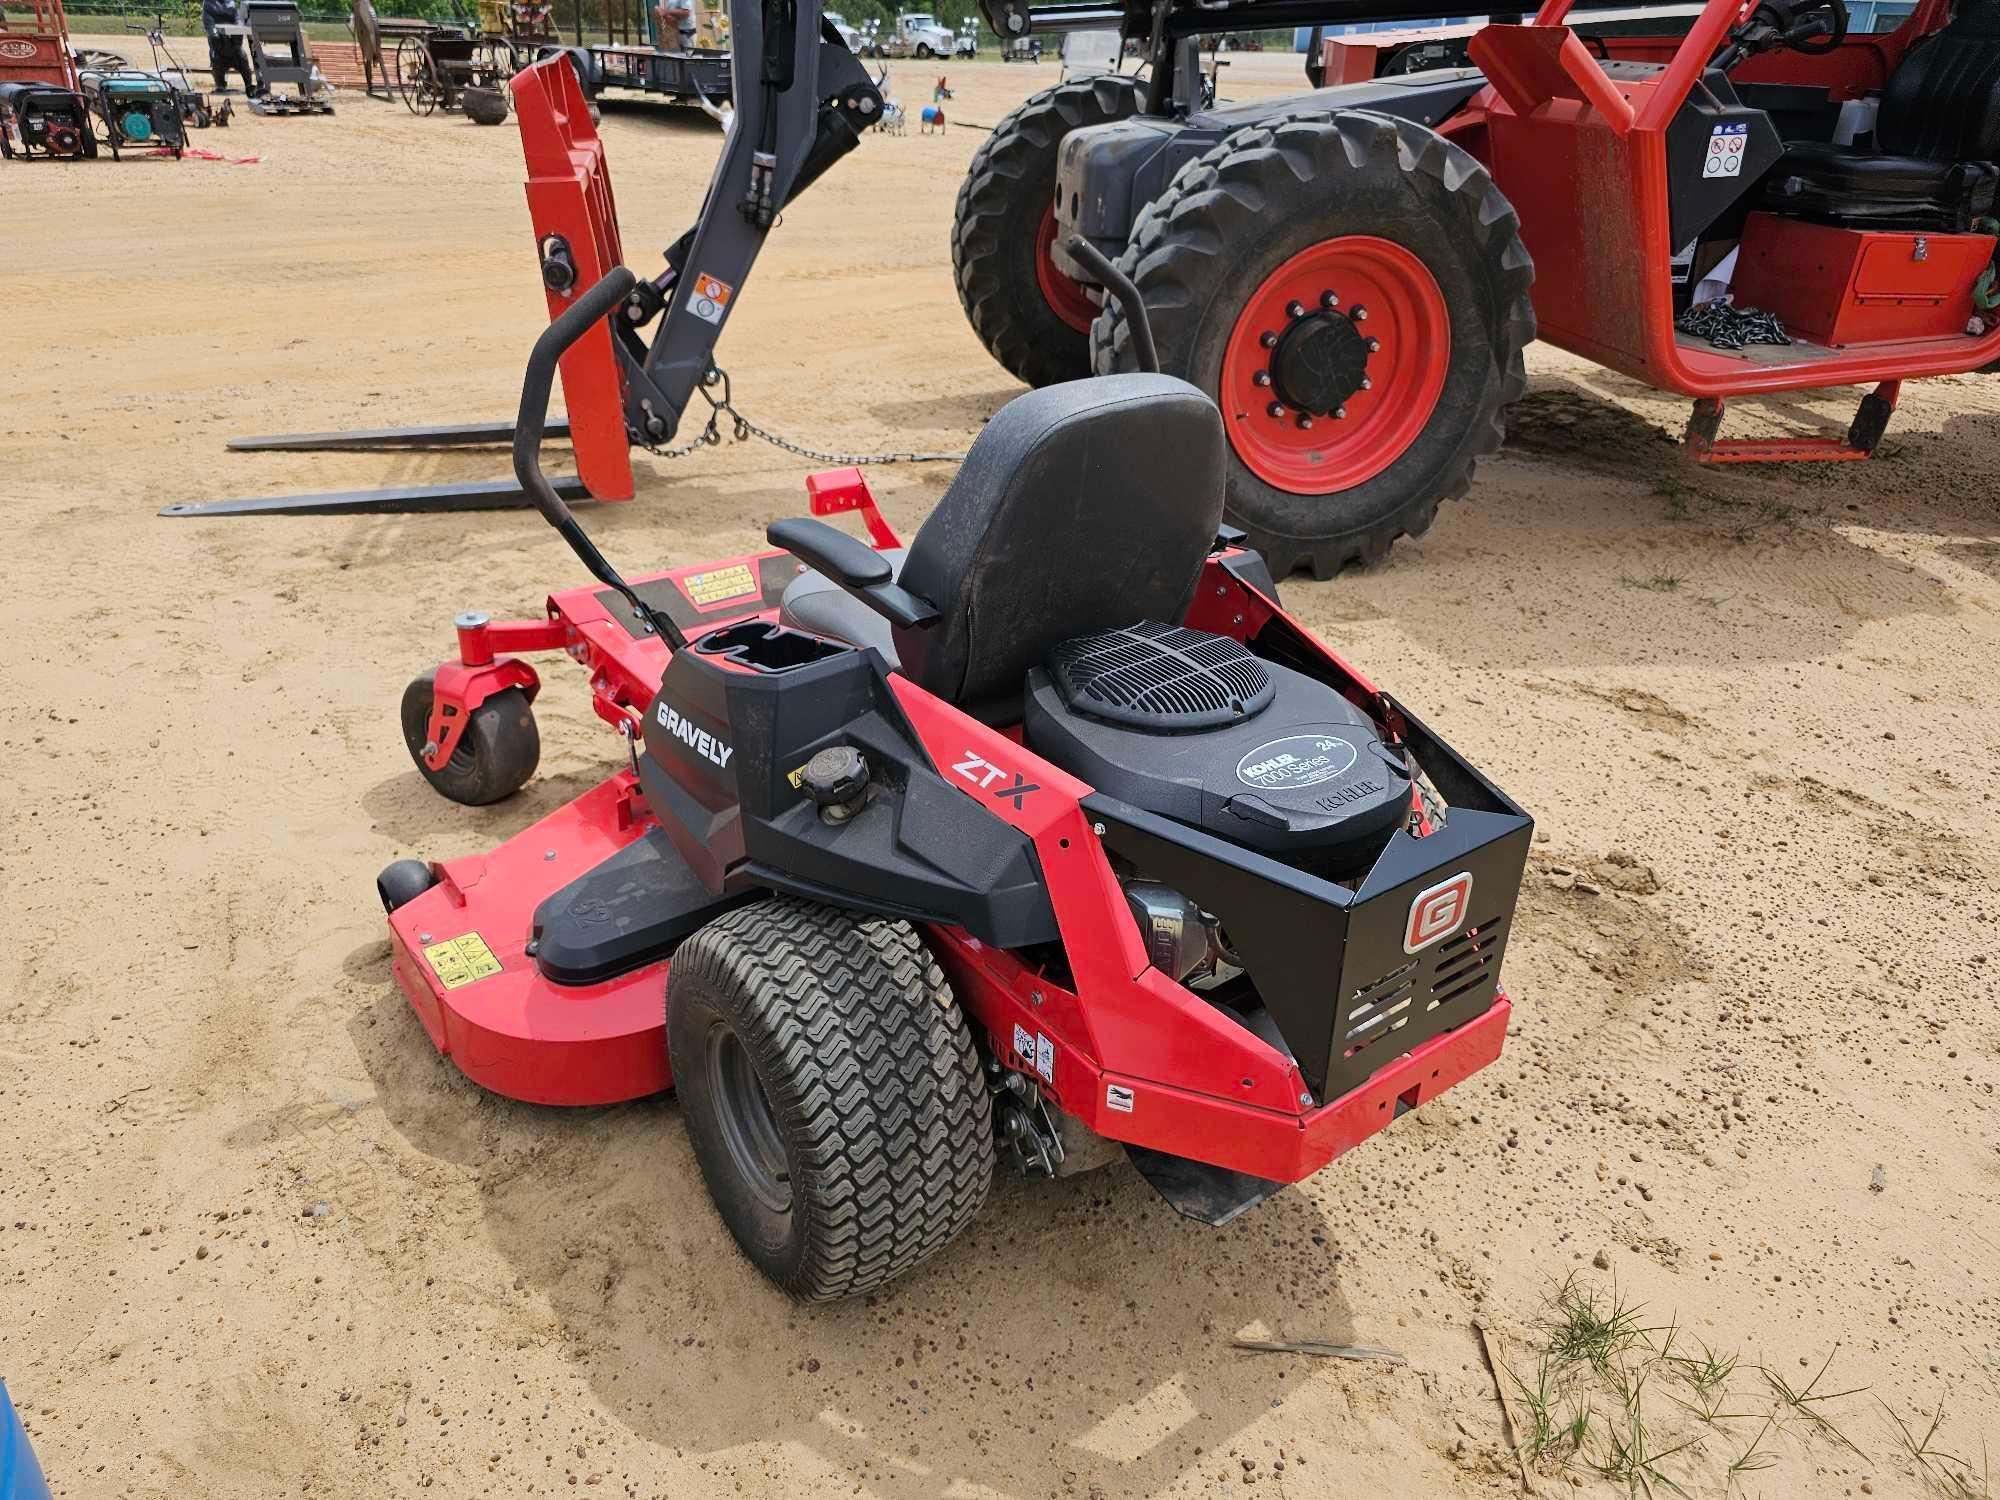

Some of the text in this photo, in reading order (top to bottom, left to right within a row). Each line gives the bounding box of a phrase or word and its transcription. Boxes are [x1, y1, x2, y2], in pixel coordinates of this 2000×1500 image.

[657, 701, 734, 768] GRAVELY
[1315, 739, 1337, 752] 24
[1242, 753, 1301, 778] KOHLER
[1254, 768, 1292, 786] 7000
[1289, 755, 1330, 774] Series
[1315, 780, 1384, 812] KOHLER
